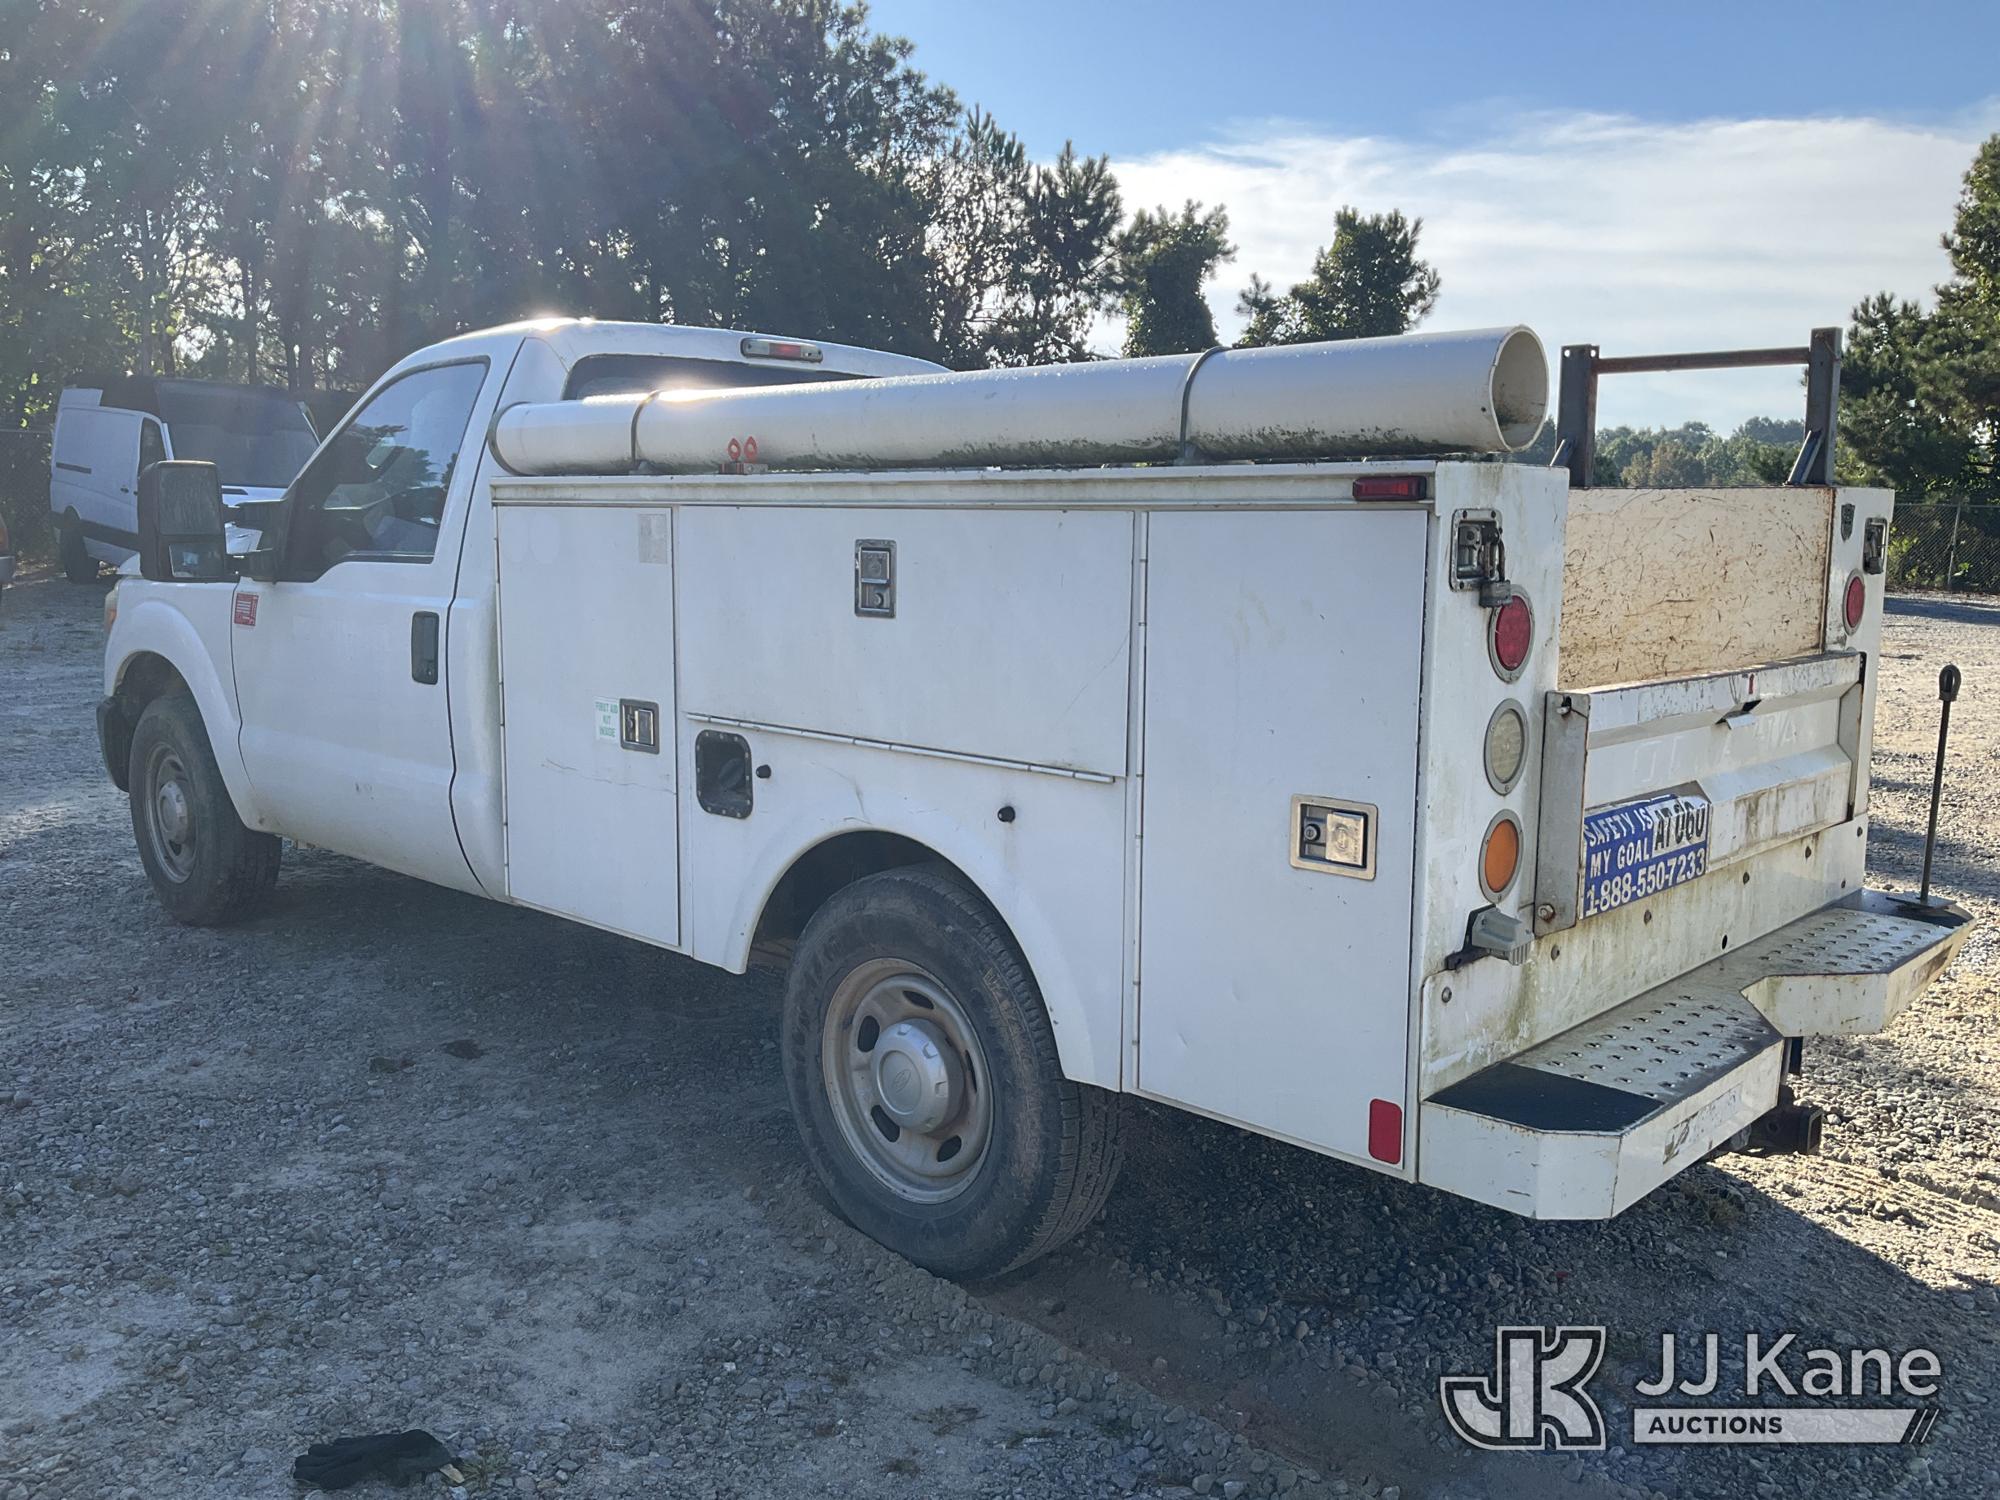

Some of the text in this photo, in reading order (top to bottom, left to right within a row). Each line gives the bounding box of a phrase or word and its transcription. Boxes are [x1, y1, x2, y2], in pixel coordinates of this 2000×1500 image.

[1584, 806, 1654, 847] SAFETY IS
[1590, 837, 1650, 879] MY GOAL
[1585, 847, 1705, 917] 1-888-550-7233
